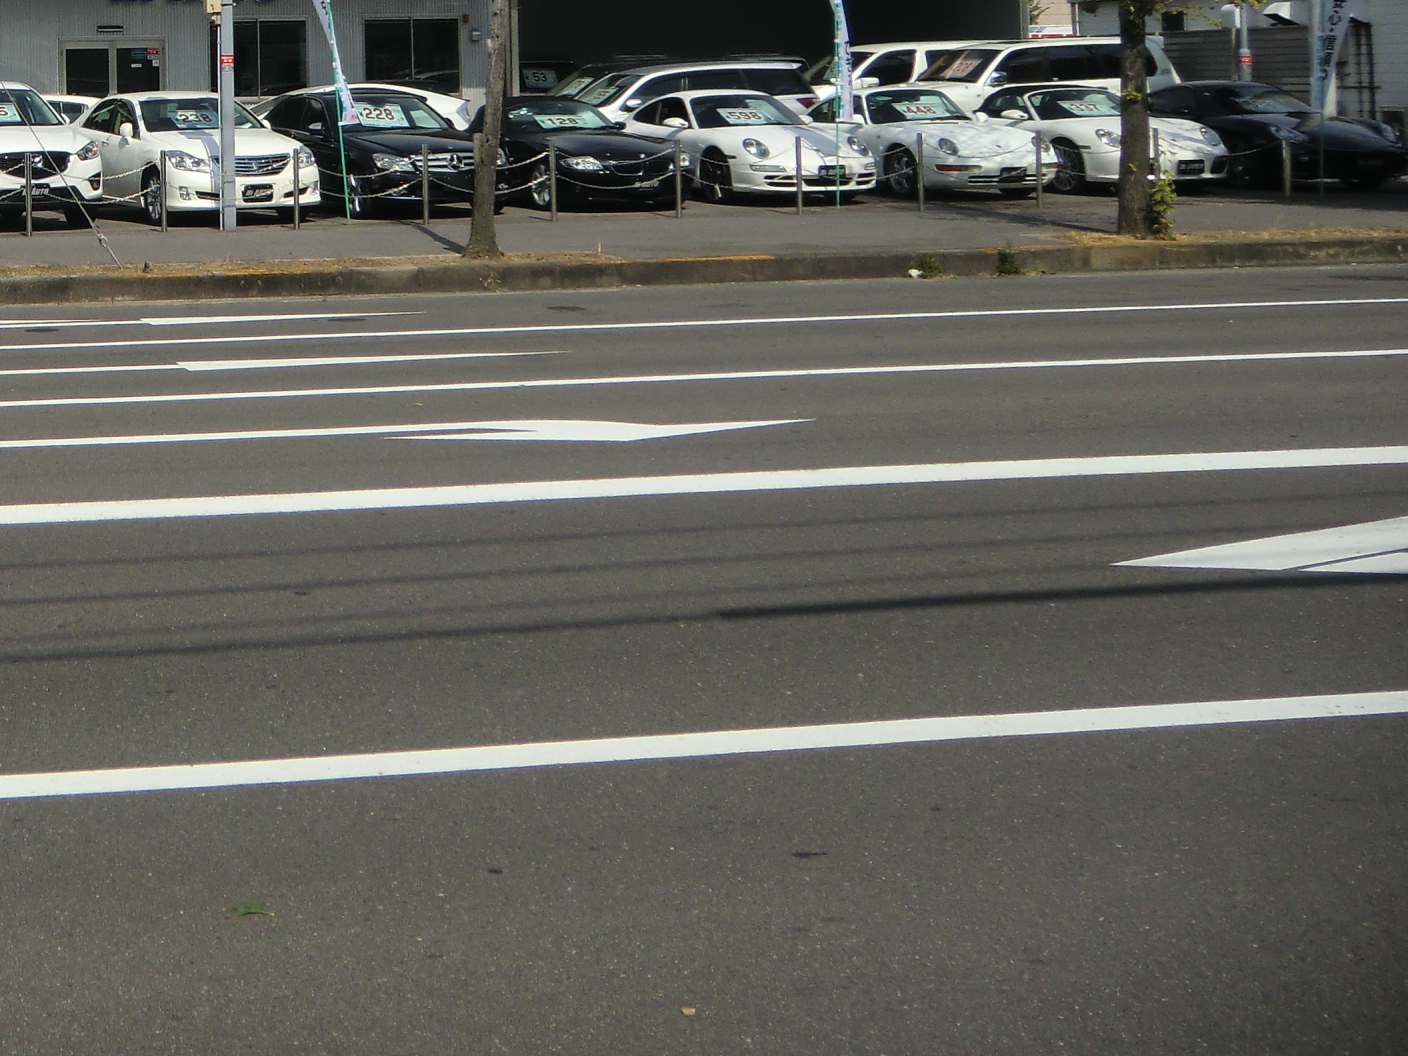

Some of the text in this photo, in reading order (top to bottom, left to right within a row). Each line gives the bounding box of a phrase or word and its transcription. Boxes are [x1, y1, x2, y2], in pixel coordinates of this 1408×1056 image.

[532, 72, 547, 82] 53
[362, 107, 394, 121] 228
[906, 105, 936, 115] 448
[179, 113, 213, 123] 238
[729, 111, 762, 120] 598
[547, 117, 578, 125] 128
